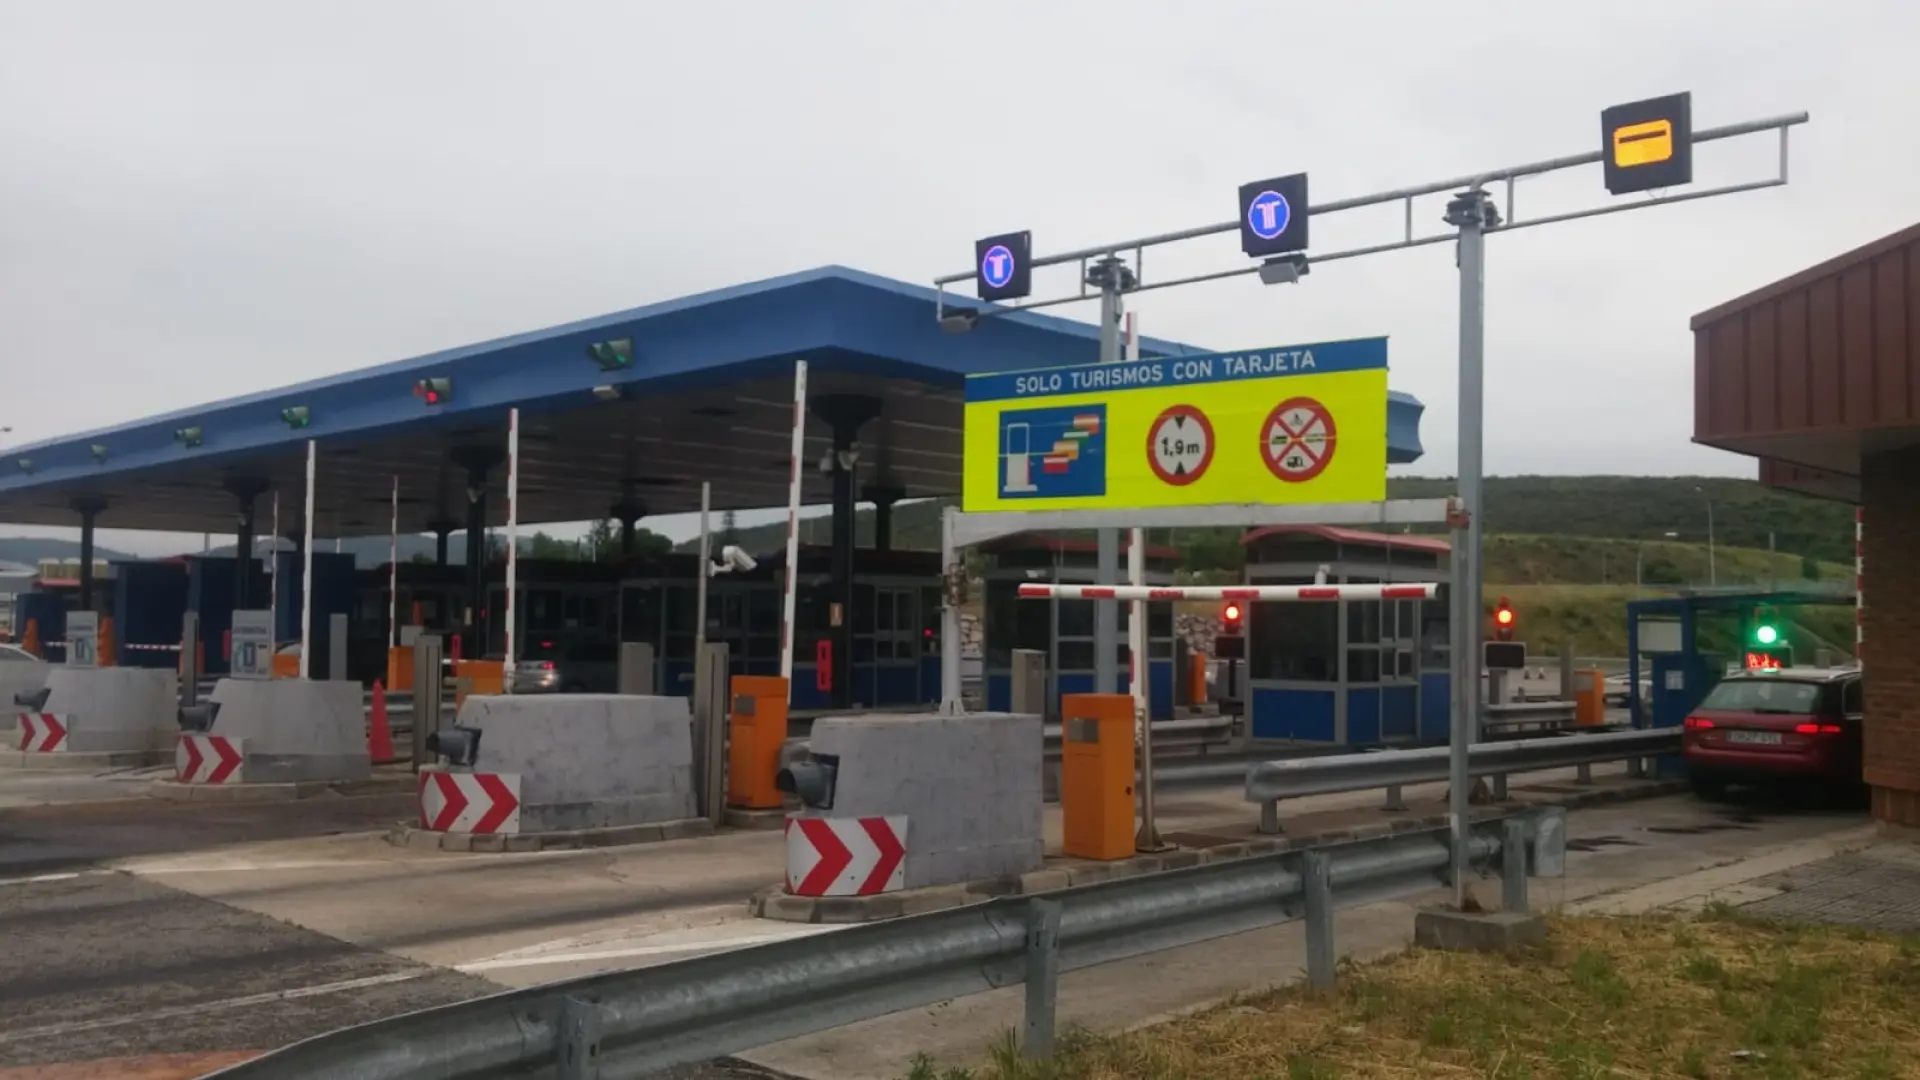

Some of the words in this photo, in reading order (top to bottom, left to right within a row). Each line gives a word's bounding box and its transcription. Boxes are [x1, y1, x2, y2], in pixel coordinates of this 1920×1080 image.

[1015, 374, 1062, 394] SOLO
[1070, 364, 1164, 389] TURISMOS
[1172, 359, 1213, 380] CON
[1222, 350, 1316, 376] TARJETA
